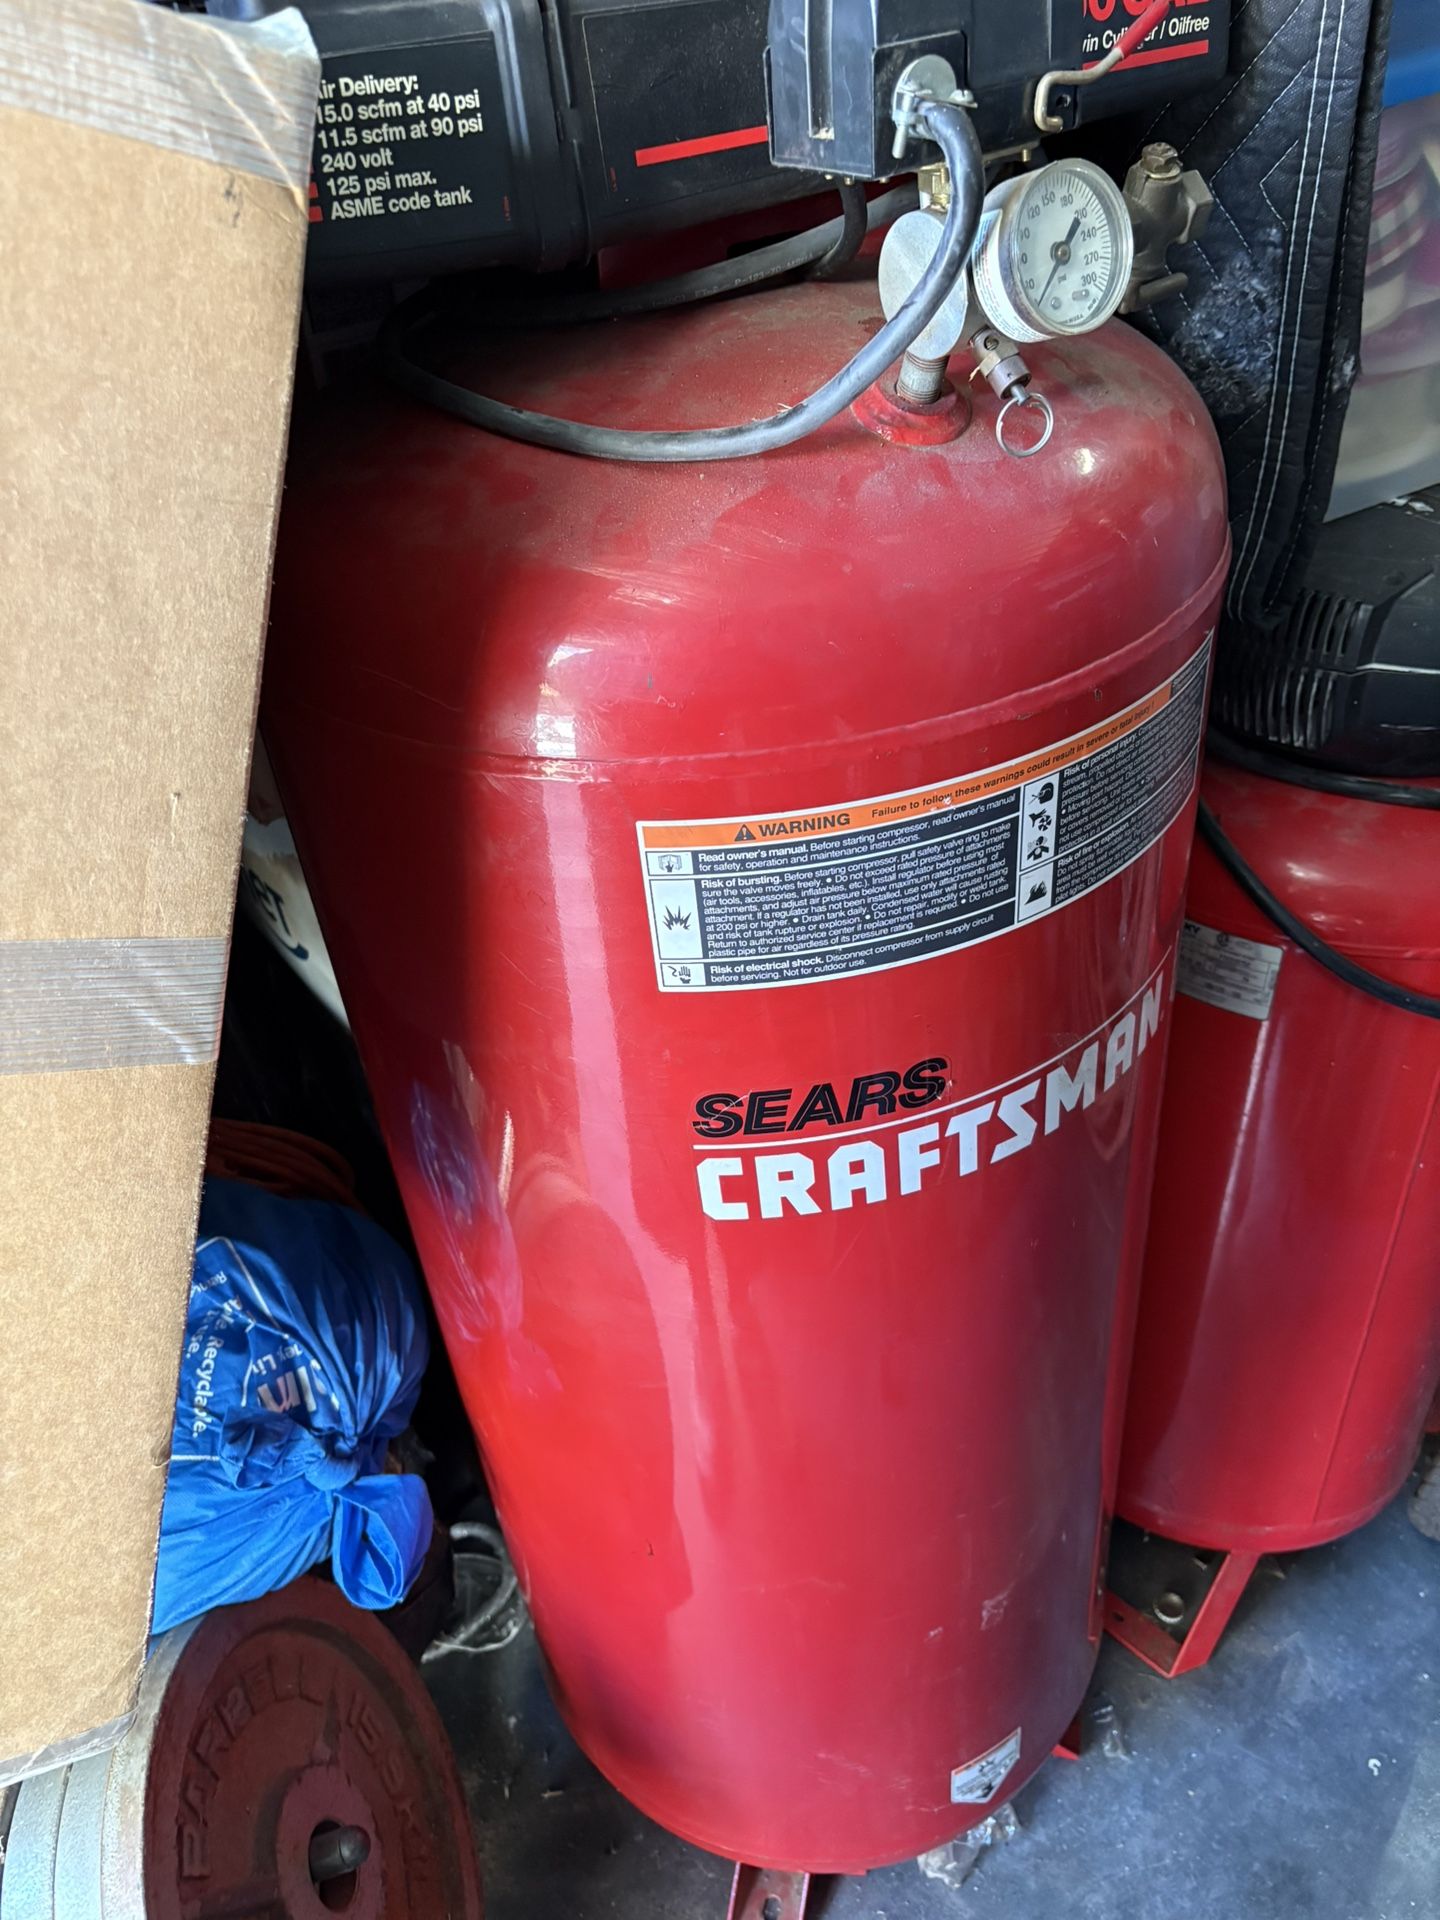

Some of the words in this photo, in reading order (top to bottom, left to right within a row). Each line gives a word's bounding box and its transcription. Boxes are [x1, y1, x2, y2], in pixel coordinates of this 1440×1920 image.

[1168, 15, 1210, 37] Oilfree
[338, 75, 419, 98] Delivery:
[316, 102, 354, 125] 15.0
[357, 99, 402, 121] scfm
[406, 96, 425, 116] at
[428, 92, 450, 113] 40
[454, 88, 481, 114] psi
[317, 126, 358, 150] 11.5
[361, 123, 407, 145] scfm
[410, 120, 429, 140] at
[430, 116, 454, 137] 90
[458, 113, 484, 138] psi
[321, 151, 357, 174] 240
[360, 148, 394, 169] volt
[326, 175, 361, 197] 125
[365, 171, 392, 196] psi
[395, 170, 438, 189] max.
[330, 196, 386, 221] ASME
[388, 191, 431, 214] code
[434, 185, 473, 208] tank
[1041, 190, 1056, 208] 150
[1059, 193, 1074, 208] 180
[1026, 204, 1041, 220] 120
[1080, 225, 1097, 243] 240
[1083, 250, 1100, 266] 270
[1080, 271, 1098, 288] 300
[758, 813, 850, 837] WARNING
[872, 800, 907, 818] Failure
[910, 797, 920, 809] to
[922, 793, 953, 807] follow
[954, 783, 981, 798] these
[983, 769, 1025, 789] warnings
[1026, 758, 1050, 774] could
[1052, 747, 1075, 764] result
[1077, 743, 1084, 753] in
[1086, 731, 1110, 748] severe
[1111, 726, 1118, 735] or
[1119, 716, 1133, 730] fatal
[1063, 766, 1080, 778] Risk
[1081, 760, 1090, 770] of
[726, 850, 766, 860] owner's
[768, 845, 808, 856] manual.
[810, 841, 840, 851] Before
[842, 834, 875, 847] starting
[745, 858, 788, 869] operation
[790, 855, 808, 863] and
[810, 845, 867, 861] maintenance
[737, 875, 782, 887] bursting.
[784, 872, 813, 881] Before
[814, 866, 846, 878] starting
[847, 856, 900, 873] compressor,
[1057, 855, 1074, 868] Risk
[744, 891, 798, 903] accessories,
[801, 884, 846, 897] inflatables,
[765, 884, 795, 892] moves
[834, 875, 848, 883] Do
[849, 872, 863, 880] not
[749, 935, 794, 945] authorized
[796, 930, 826, 940] service
[828, 926, 855, 936] center
[708, 949, 735, 958] plastic
[737, 948, 756, 956] pipe
[783, 939, 829, 952] regardless
[710, 966, 732, 974] Risk
[745, 961, 789, 971] electrical
[791, 956, 823, 967] shock.
[825, 948, 873, 962] Disconnect
[740, 971, 780, 982] servicing.
[813, 962, 847, 972] outdoor
[848, 959, 866, 967] use.
[693, 1057, 949, 1139] SEARS
[696, 973, 1164, 1222] CRAFTSMAN
